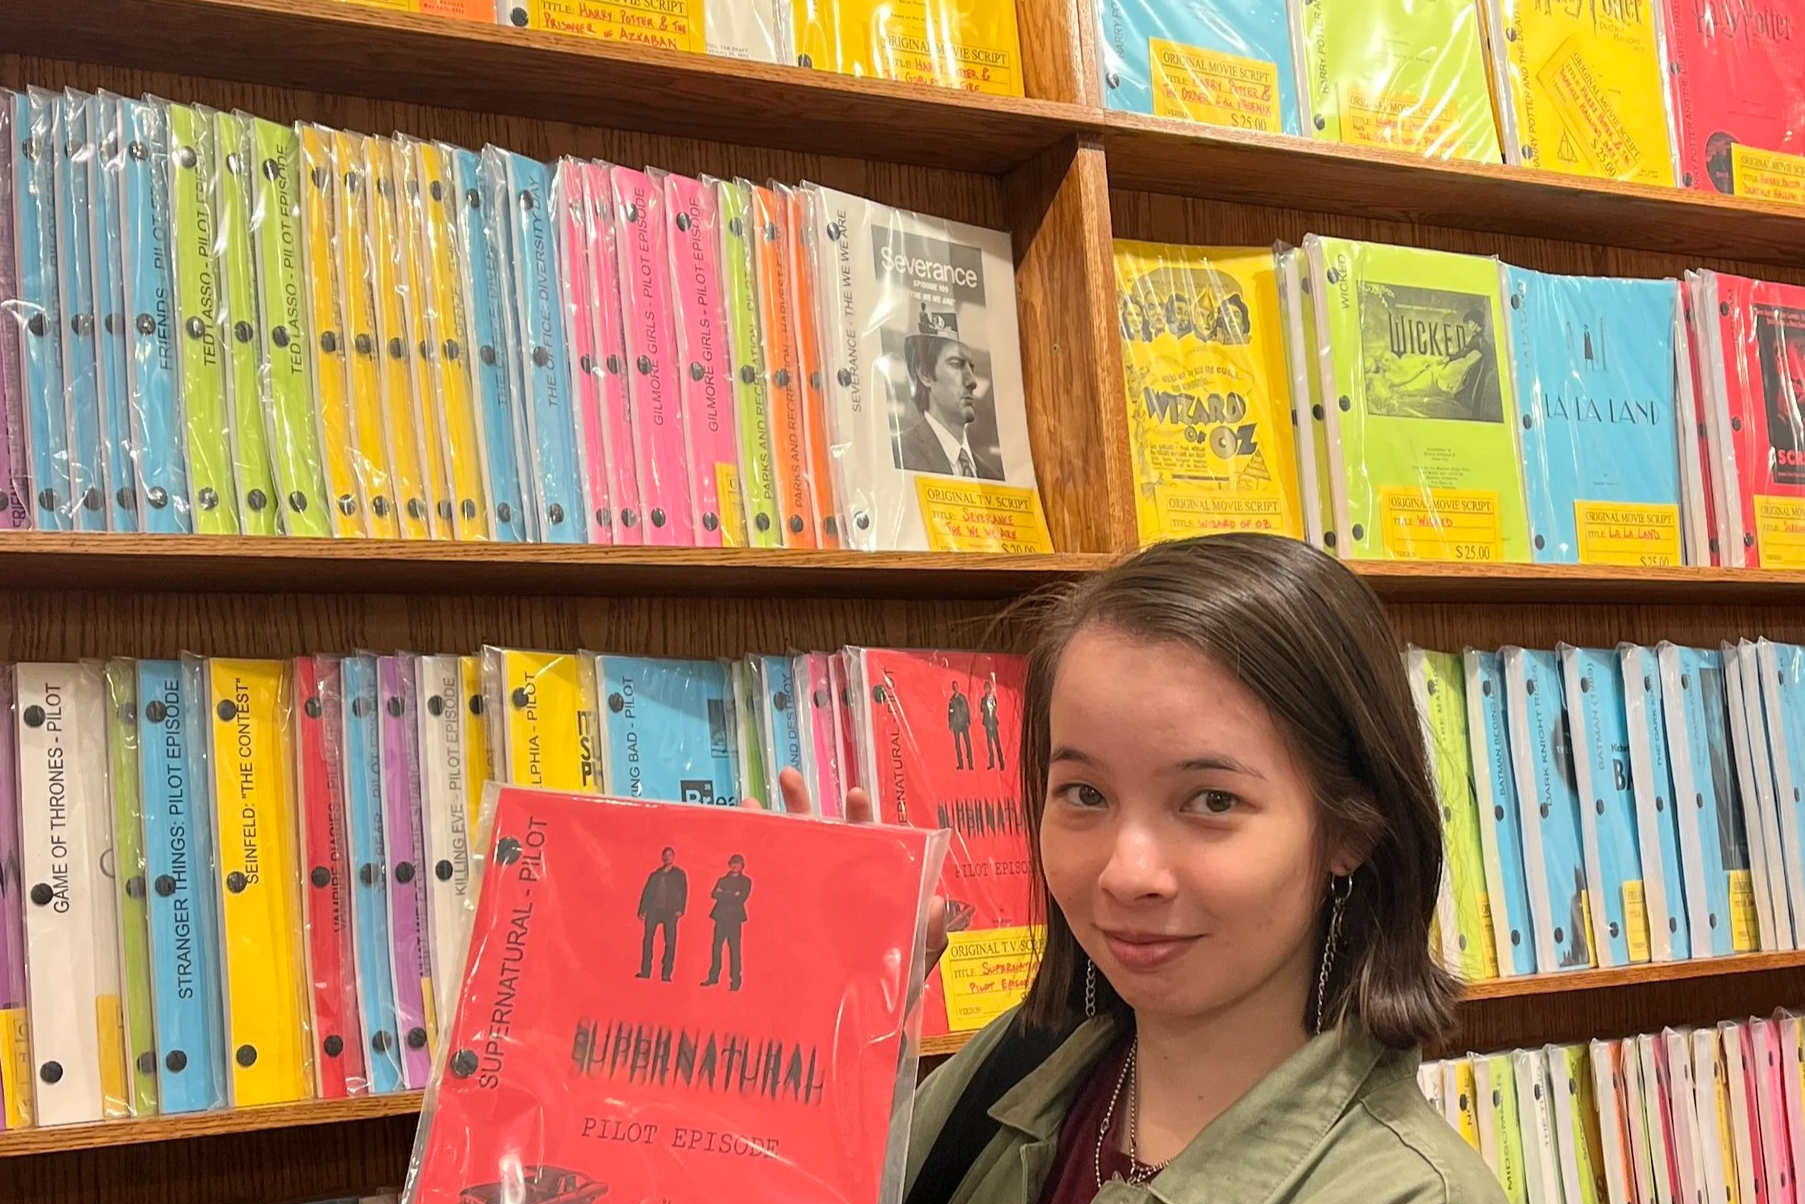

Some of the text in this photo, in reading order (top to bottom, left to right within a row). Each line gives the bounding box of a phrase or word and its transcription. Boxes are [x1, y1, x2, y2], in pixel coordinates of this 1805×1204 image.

[544, 13, 677, 50] PRISONER AZKABAN
[579, 6, 687, 34] HARRY & THE
[972, 48, 1008, 65] SCRIPT
[1163, 51, 1270, 83] ORIGINAL MOVIE SCRIPT
[1618, 122, 1642, 158] SCRIPT
[696, 264, 710, 308] PILOT
[881, 246, 978, 288] Severance
[1337, 253, 1350, 309] WICKED
[279, 220, 304, 376] TED LASSO PILOT
[532, 214, 559, 408] THE DIVERSITY
[634, 186, 664, 427] GILMORE GIRLS PILOT EPISODE
[838, 209, 863, 412] SEVERANCE THE WE WE ARE
[156, 286, 174, 372] FRIENDS
[202, 332, 217, 367] TED
[699, 318, 715, 362] GIRLS
[1388, 311, 1466, 359] WICKED
[702, 365, 720, 433] GILMORE
[1143, 386, 1246, 427] WIZARD
[1545, 392, 1660, 425] LA LA LAND
[1209, 422, 1259, 459] OZ
[758, 455, 773, 500] PARKS
[790, 428, 806, 509] PARKS AND
[927, 488, 1028, 510] ORIGINAL SCRIPT
[962, 507, 1014, 526] SEVERANCE
[1168, 497, 1279, 512] ORIGINAL MOVIE SCRIPT
[1462, 501, 1491, 511] SCRIPT
[1586, 511, 1672, 524] ORIGINAL MOVIE SCRIPT
[968, 527, 979, 538] WE
[1000, 528, 1017, 539] ARE
[1609, 526, 1660, 540] LA LA LAND
[525, 671, 537, 721] PILOT
[624, 676, 636, 719] PILOT
[628, 732, 640, 762] BAD
[1592, 710, 1605, 770] BATMAN
[46, 682, 69, 914] GAME OF THRONES PILOT
[236, 677, 259, 885] SEINFELD: "THE CONTEST"
[443, 677, 467, 896] KILLING EVE PILOT EPISODE
[1541, 767, 1553, 806] DARK
[165, 680, 194, 1000] STRANGER THINGS: PILOT EPISODE
[478, 817, 548, 1089] SUPERNATURAL PILOT
[951, 942, 1000, 958] ORIGINAL
[970, 981, 995, 994] PILOT
[571, 1016, 824, 1106] SUPERNATURAL
[581, 1117, 780, 1160] PILOT EPISODE
